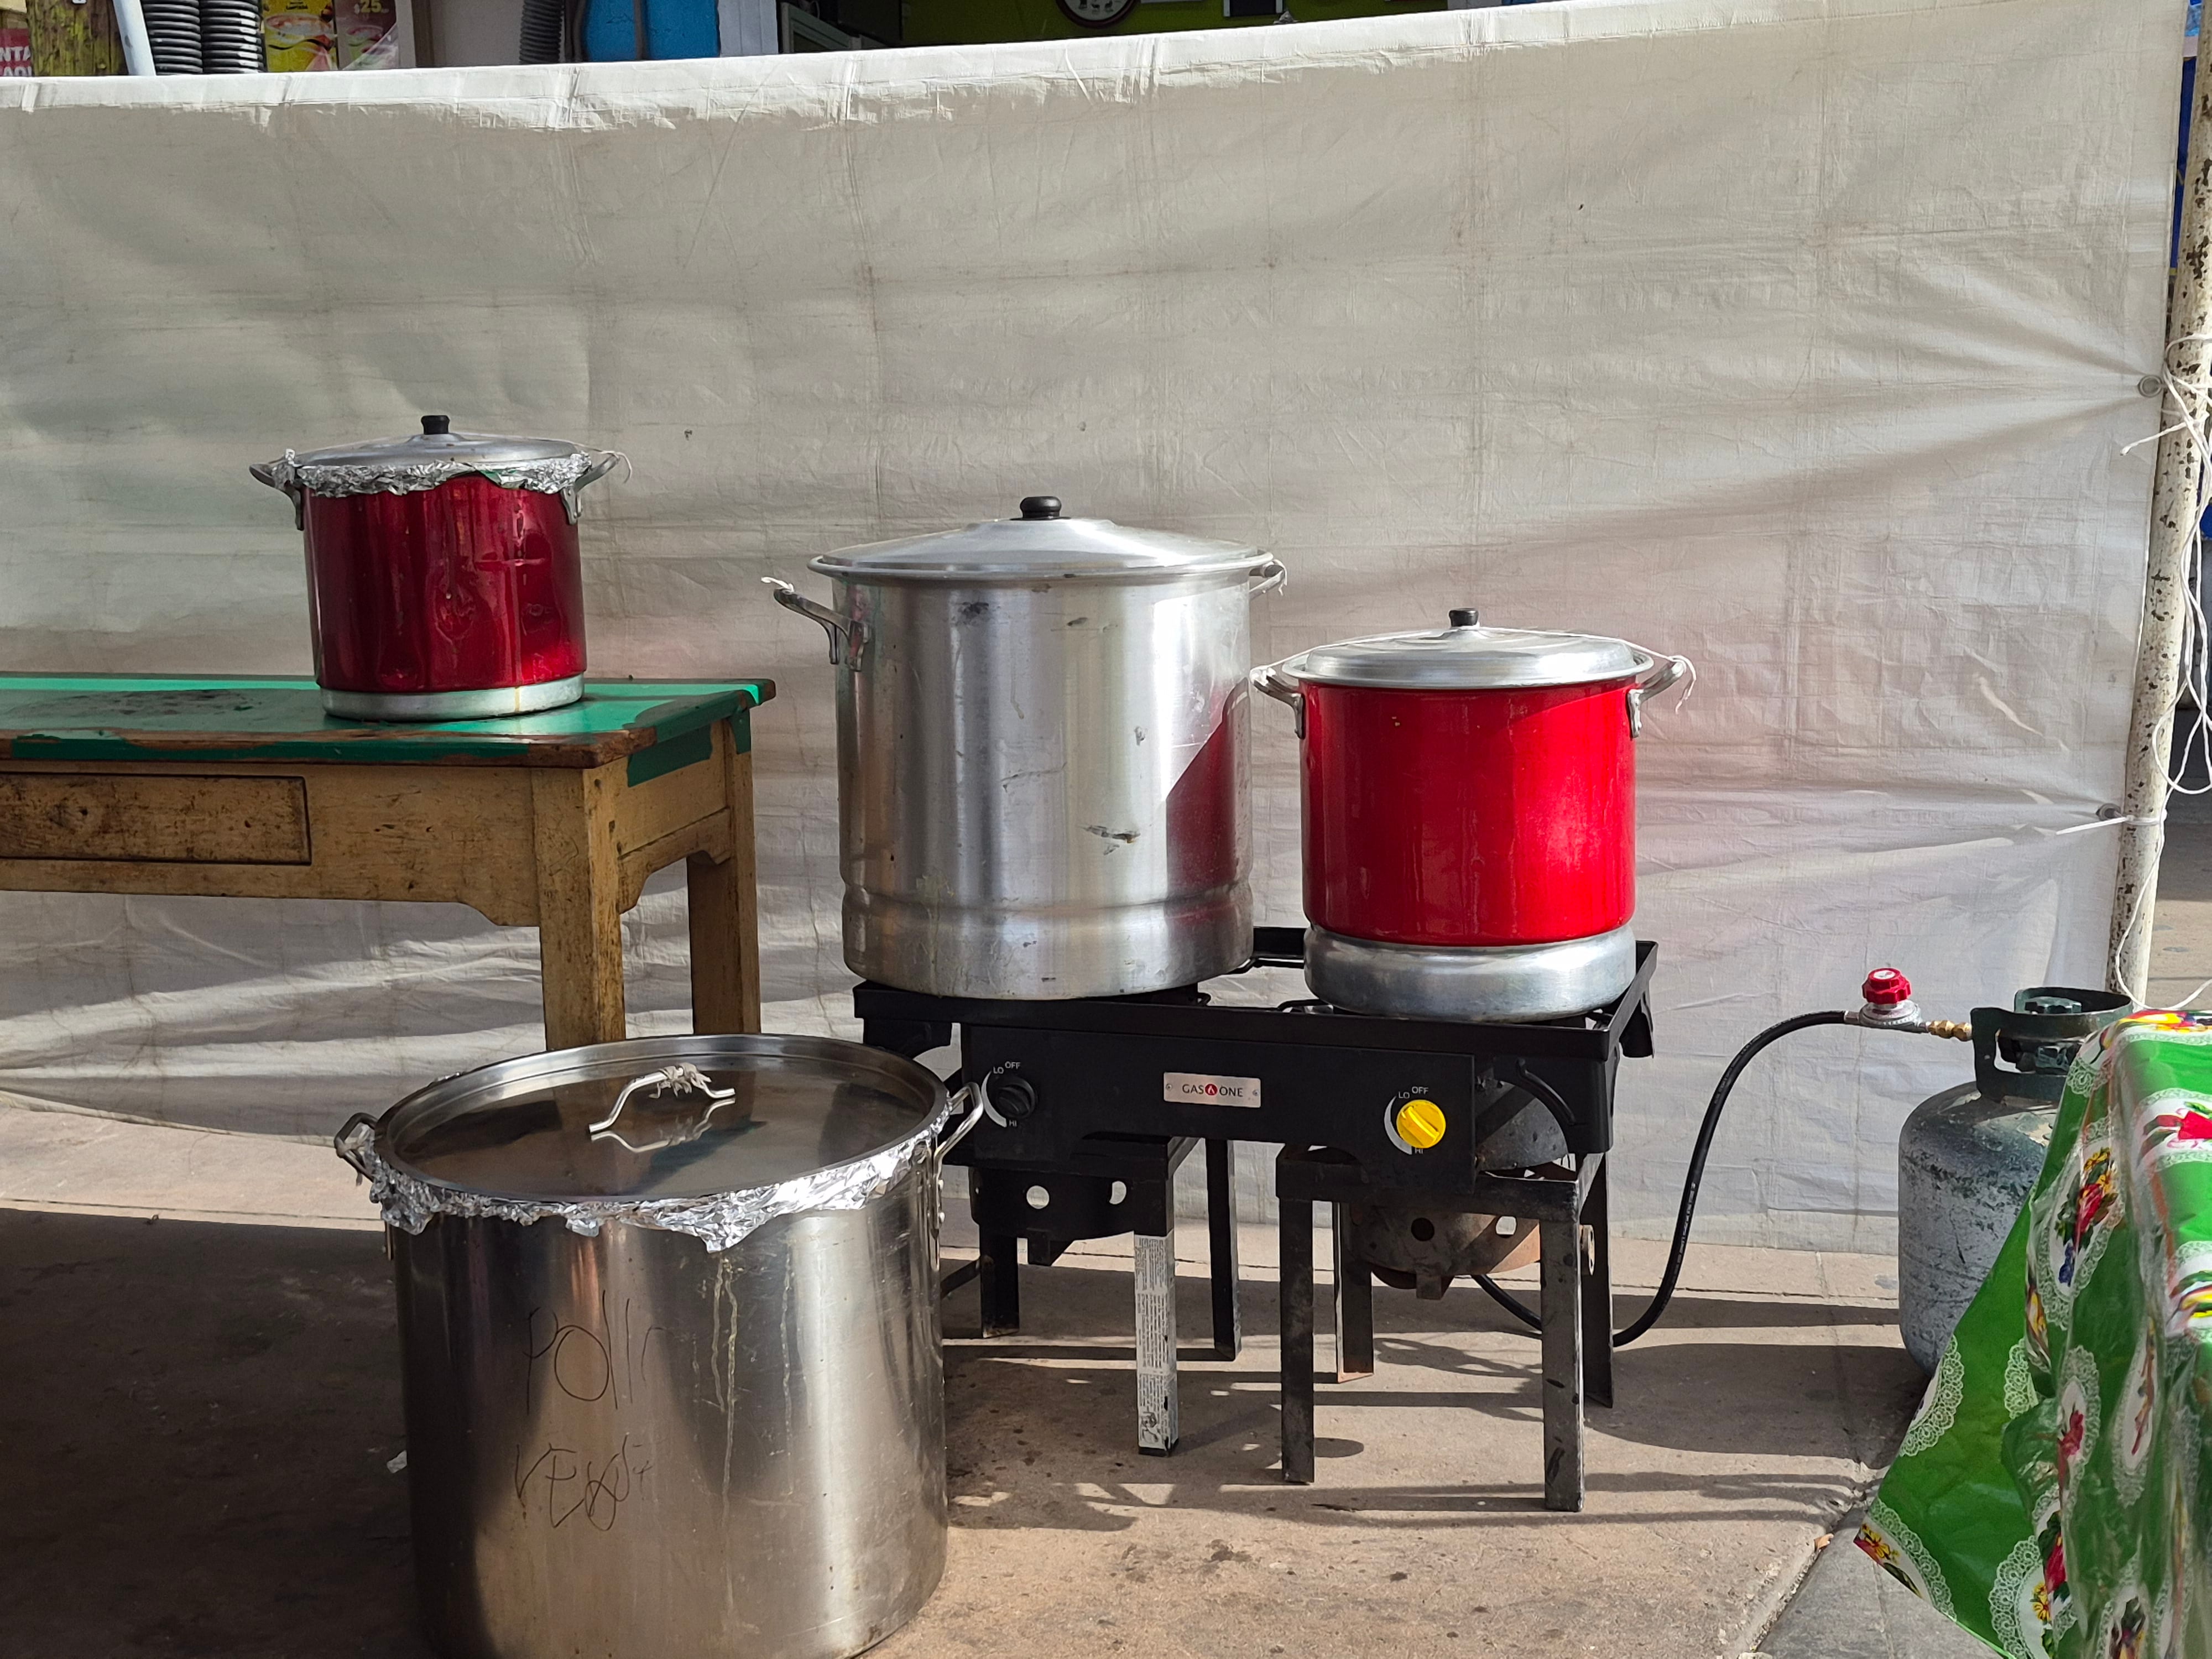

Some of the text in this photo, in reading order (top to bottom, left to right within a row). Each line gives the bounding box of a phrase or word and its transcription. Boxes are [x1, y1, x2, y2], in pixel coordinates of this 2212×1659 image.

[1005, 1061, 1020, 1070] OFF
[1182, 1083, 1243, 1097] GAS ONE
[1412, 1086, 1428, 1094] OFF
